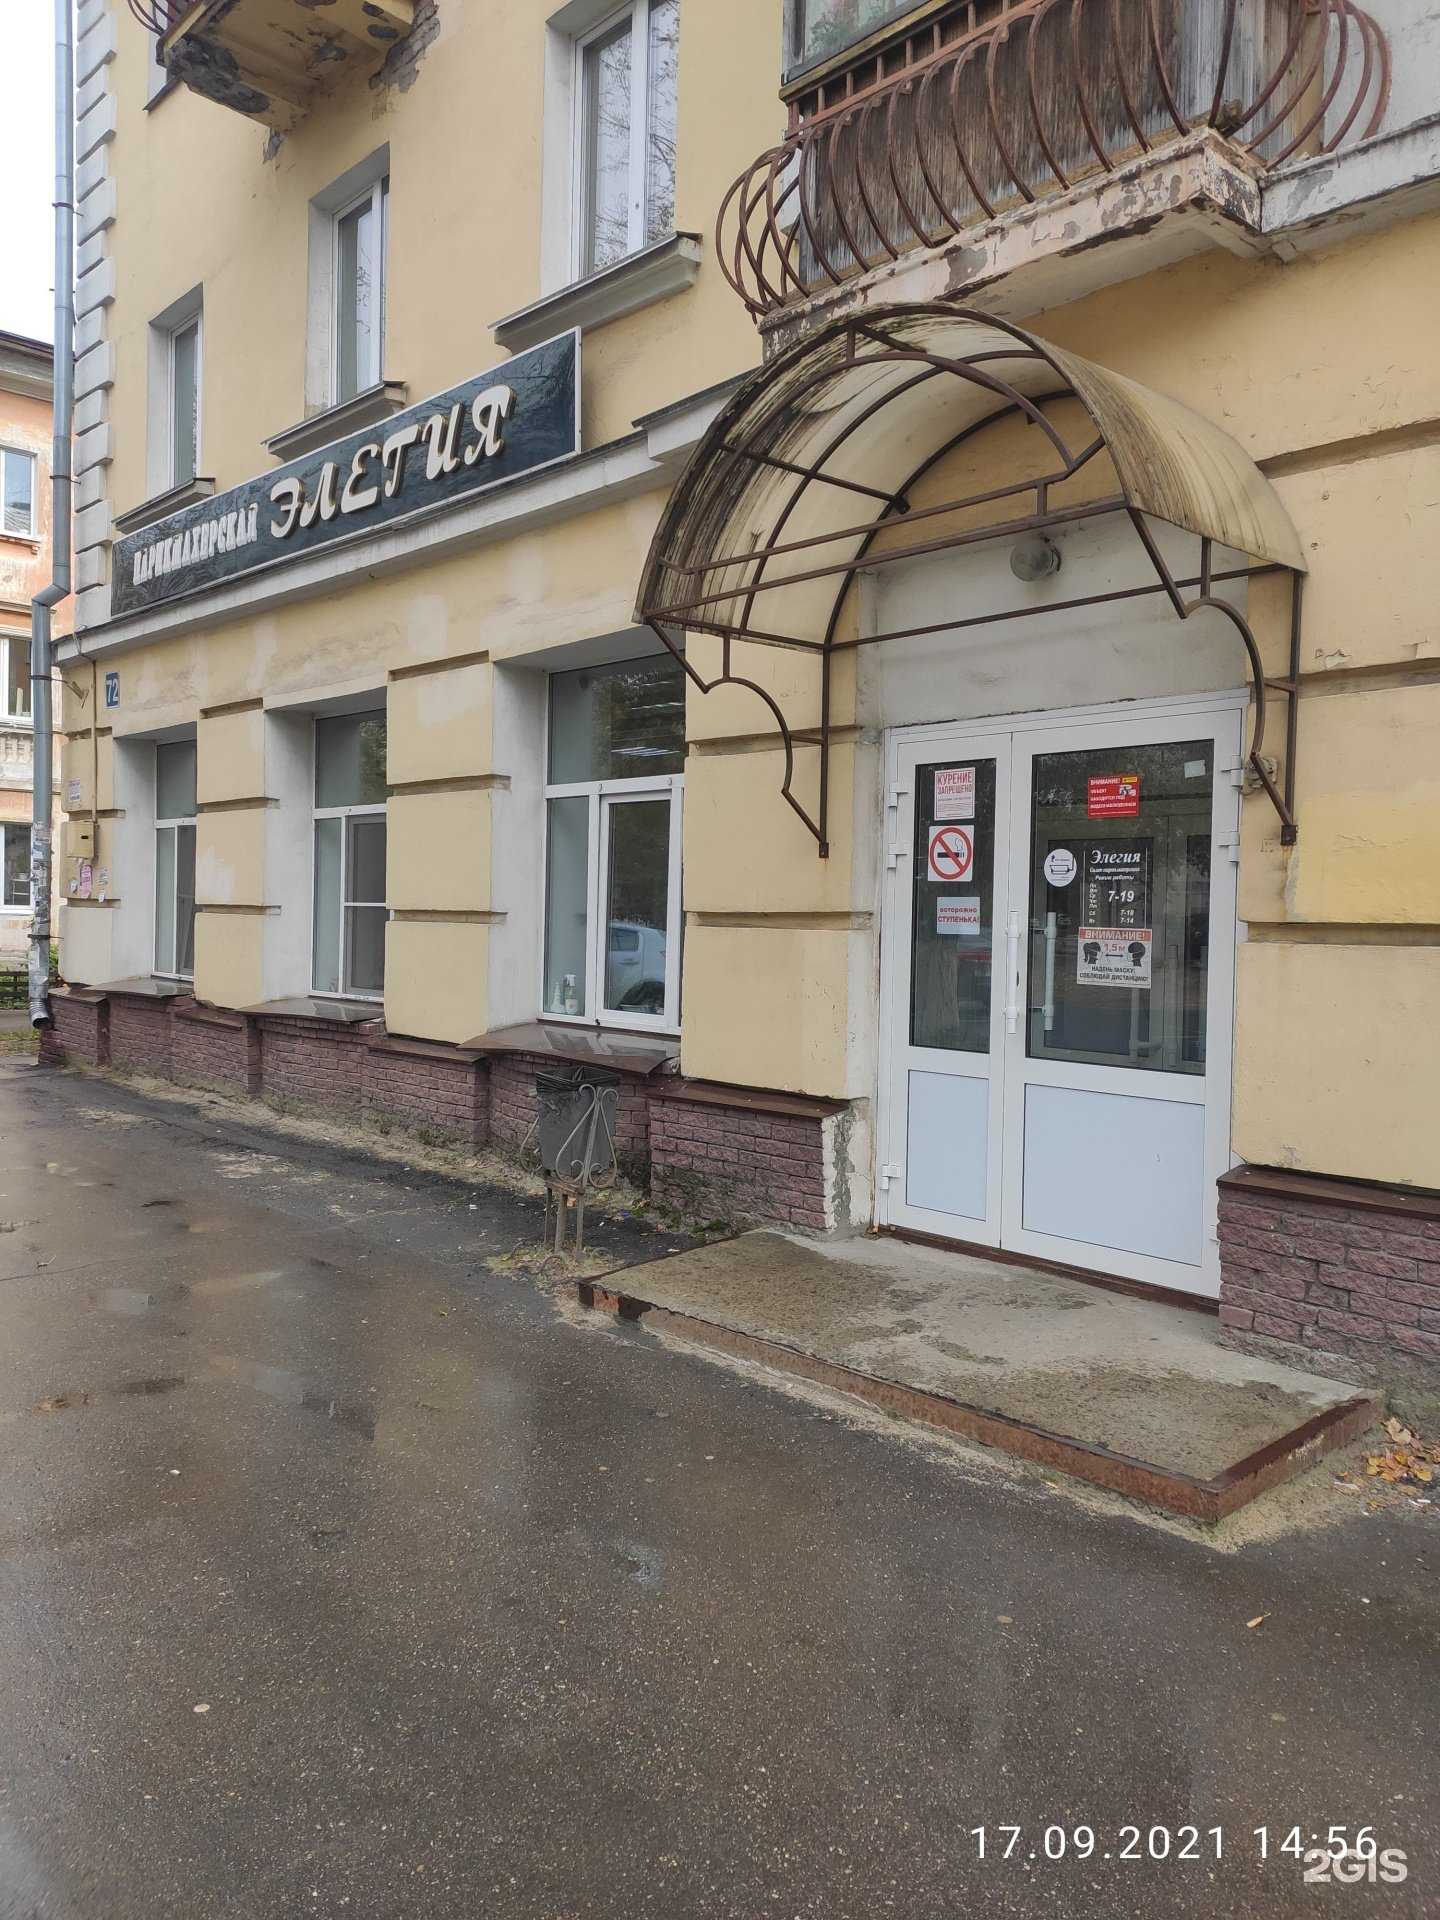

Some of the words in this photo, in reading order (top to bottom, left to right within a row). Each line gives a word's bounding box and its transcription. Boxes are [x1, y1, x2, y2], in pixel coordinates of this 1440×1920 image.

[132, 502, 259, 587] ПАРИКМАХЕРСКАЯ
[270, 384, 516, 539] ЭЛЕГИЯ
[105, 679, 119, 704] 72
[937, 771, 972, 785] КУРЕНИЕ
[937, 784, 973, 794] ЗАПРЕЩЕНО
[1090, 849, 1141, 864] Элегия
[1108, 890, 1135, 903] 7-19
[1085, 930, 1145, 941] ВНИМАНИЕ!
[1103, 943, 1117, 952] 1,5
